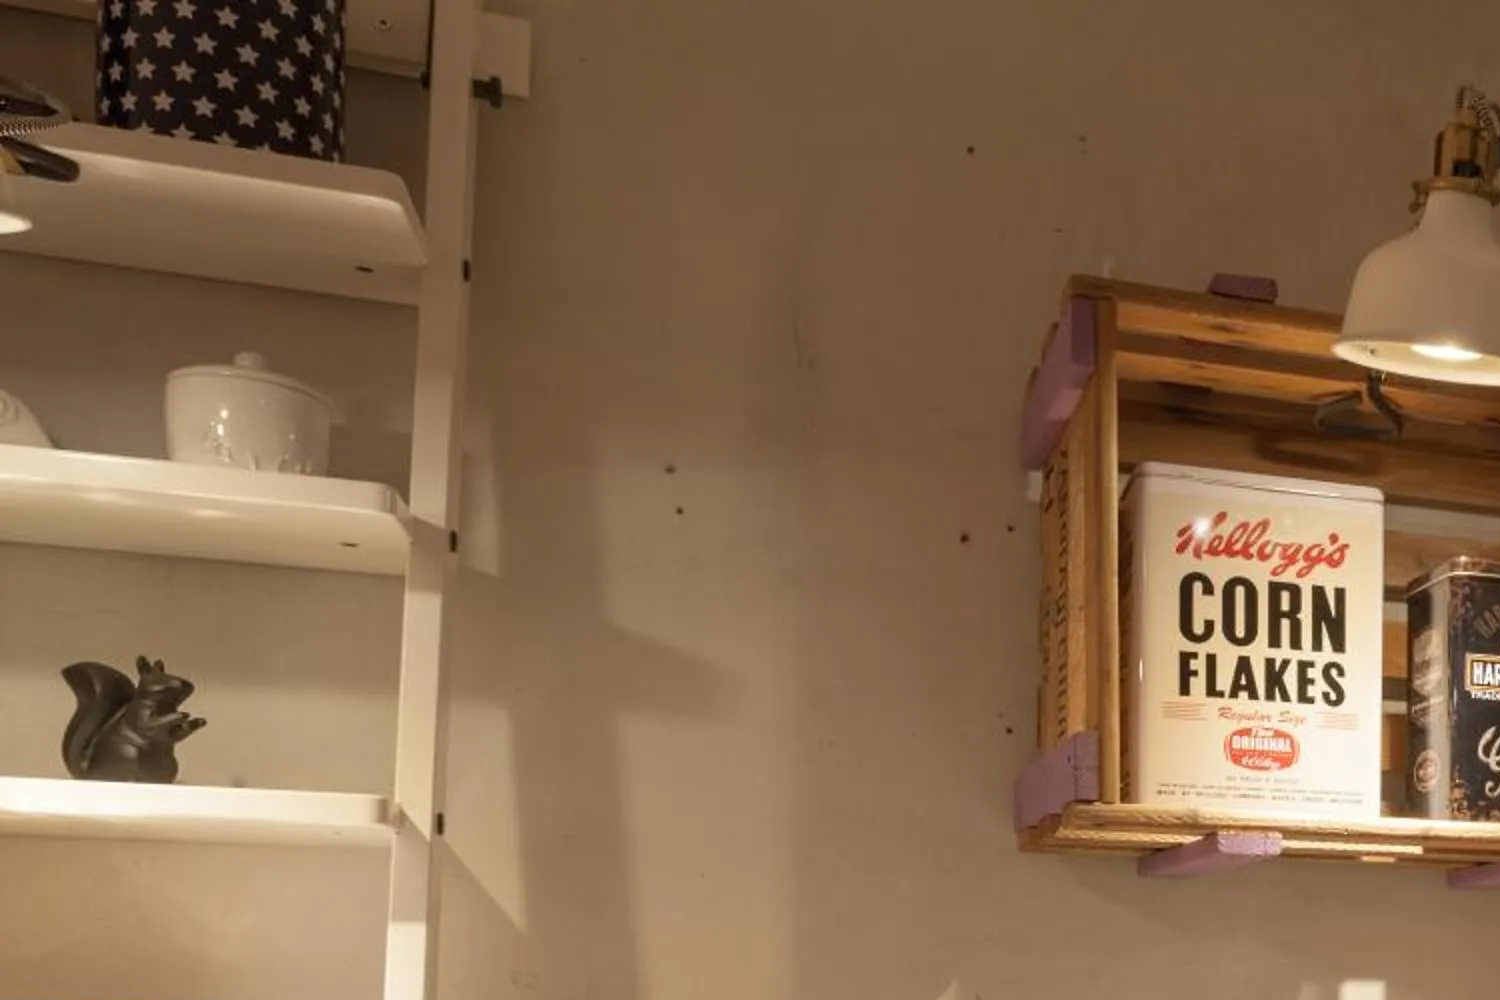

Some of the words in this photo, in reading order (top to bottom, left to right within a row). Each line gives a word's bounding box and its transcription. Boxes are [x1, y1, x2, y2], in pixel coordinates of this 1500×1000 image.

[1176, 511, 1350, 578] Kellogg's
[1179, 571, 1346, 654] CORN
[1179, 651, 1345, 707] FLAKES
[1218, 706, 1270, 724] Regular
